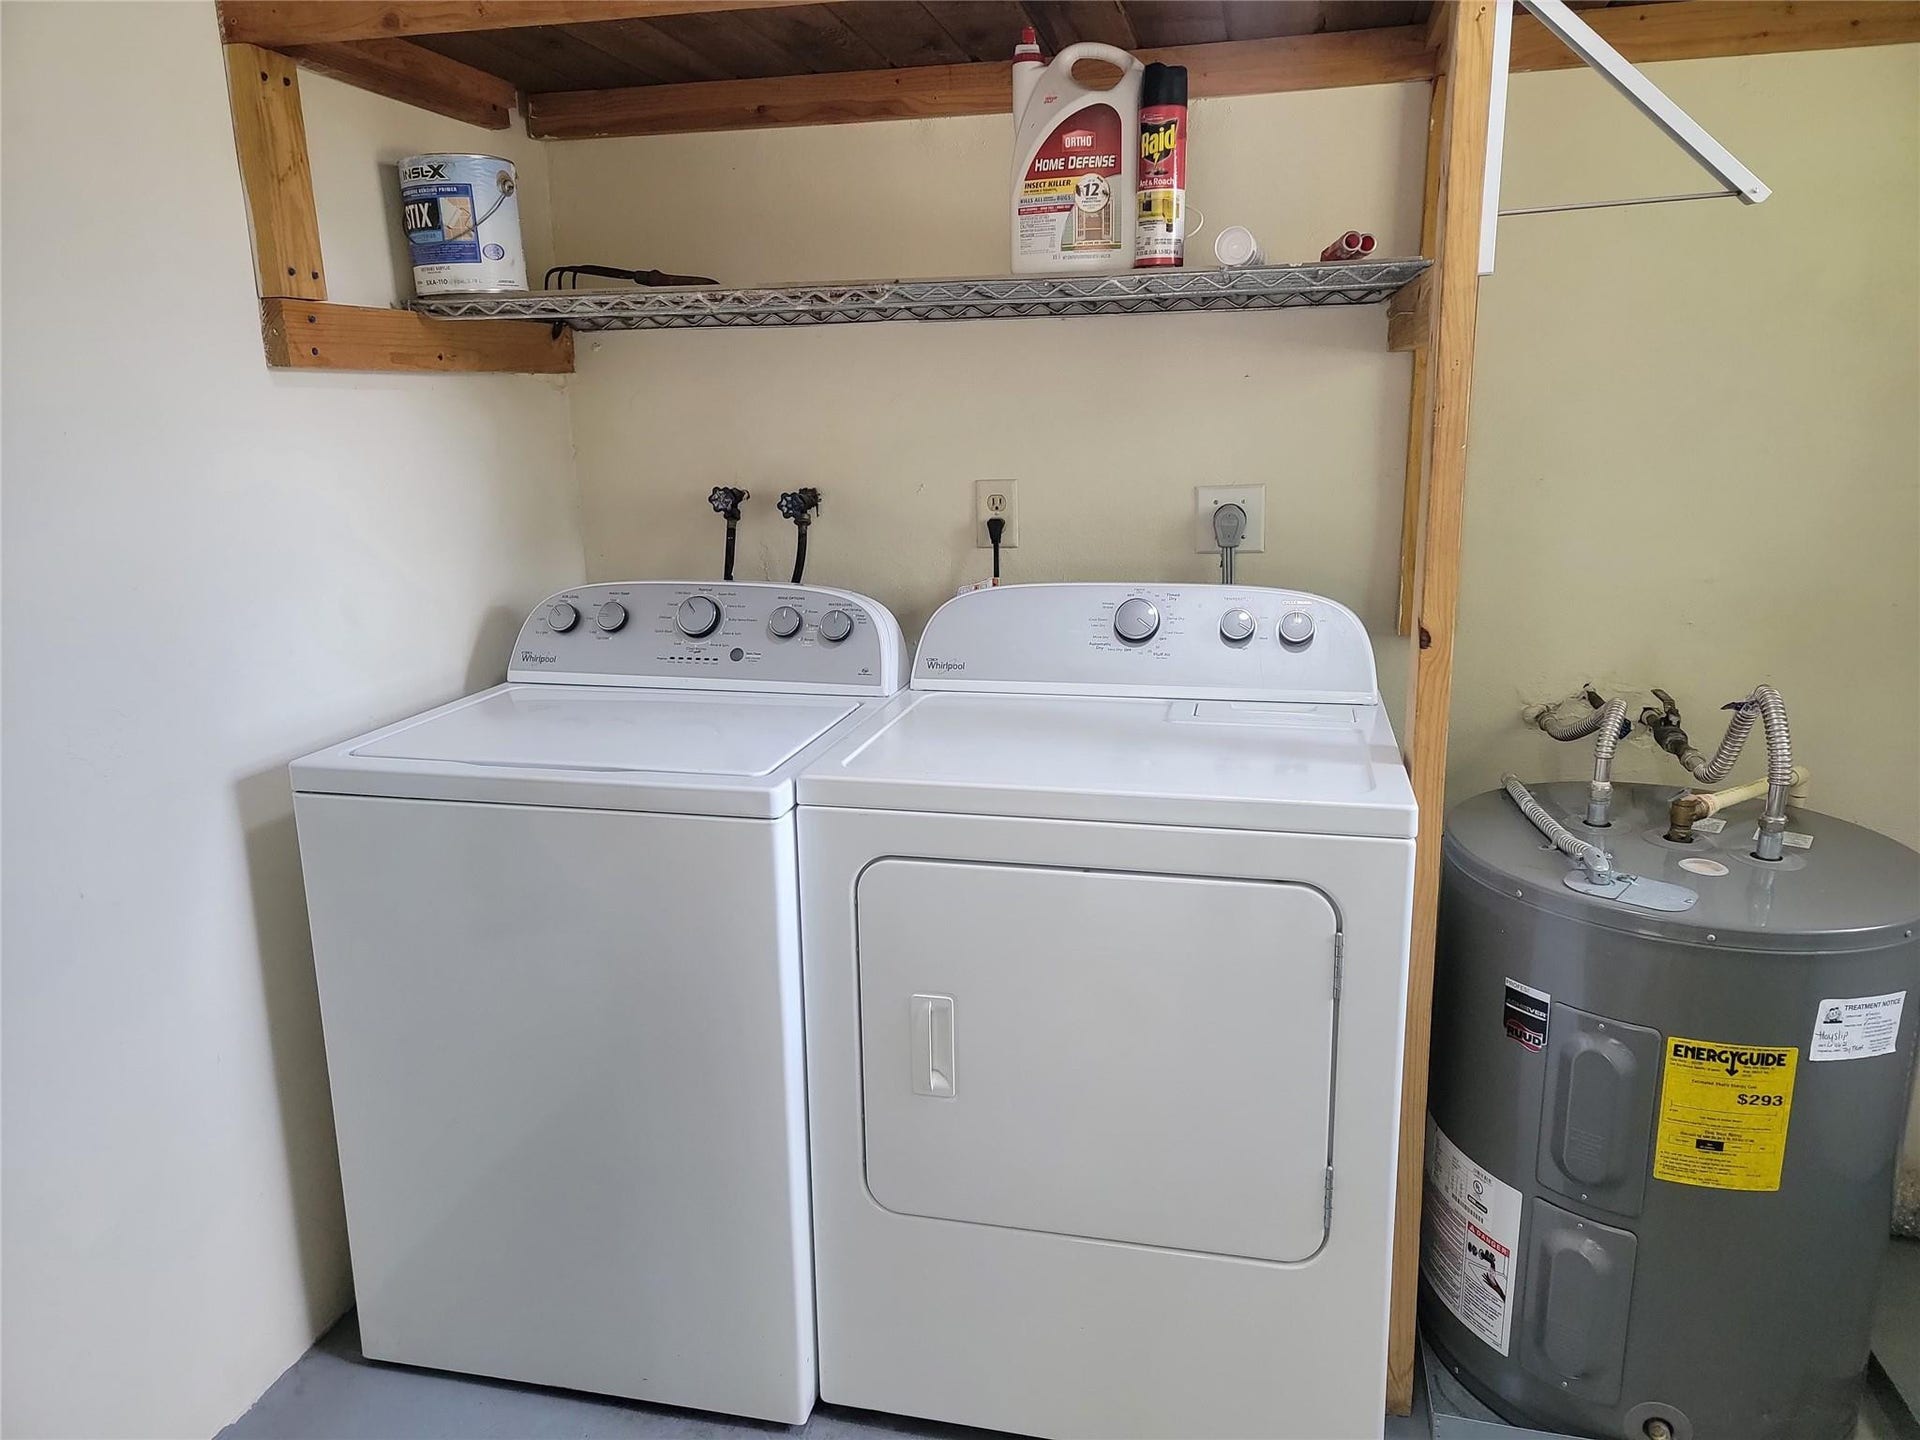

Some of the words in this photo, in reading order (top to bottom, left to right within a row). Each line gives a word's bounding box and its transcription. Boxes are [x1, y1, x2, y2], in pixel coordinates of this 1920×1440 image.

[1065, 135, 1092, 148] ORTHO
[1141, 124, 1176, 158] Raid
[1035, 157, 1065, 171] HOME
[1068, 155, 1116, 169] DEFENSE
[1024, 181, 1047, 189] INSECT
[1048, 178, 1071, 187] KILLER
[1083, 183, 1100, 196] 12
[405, 202, 432, 229] STIX
[521, 653, 556, 664] Whirlpool
[927, 661, 965, 671] Whirlpool
[1845, 1001, 1880, 1010] TREATMENT
[1882, 997, 1901, 1007] NOTICE
[1673, 1044, 1787, 1068] ENERGYGUIDE
[1737, 1093, 1783, 1107] $293
